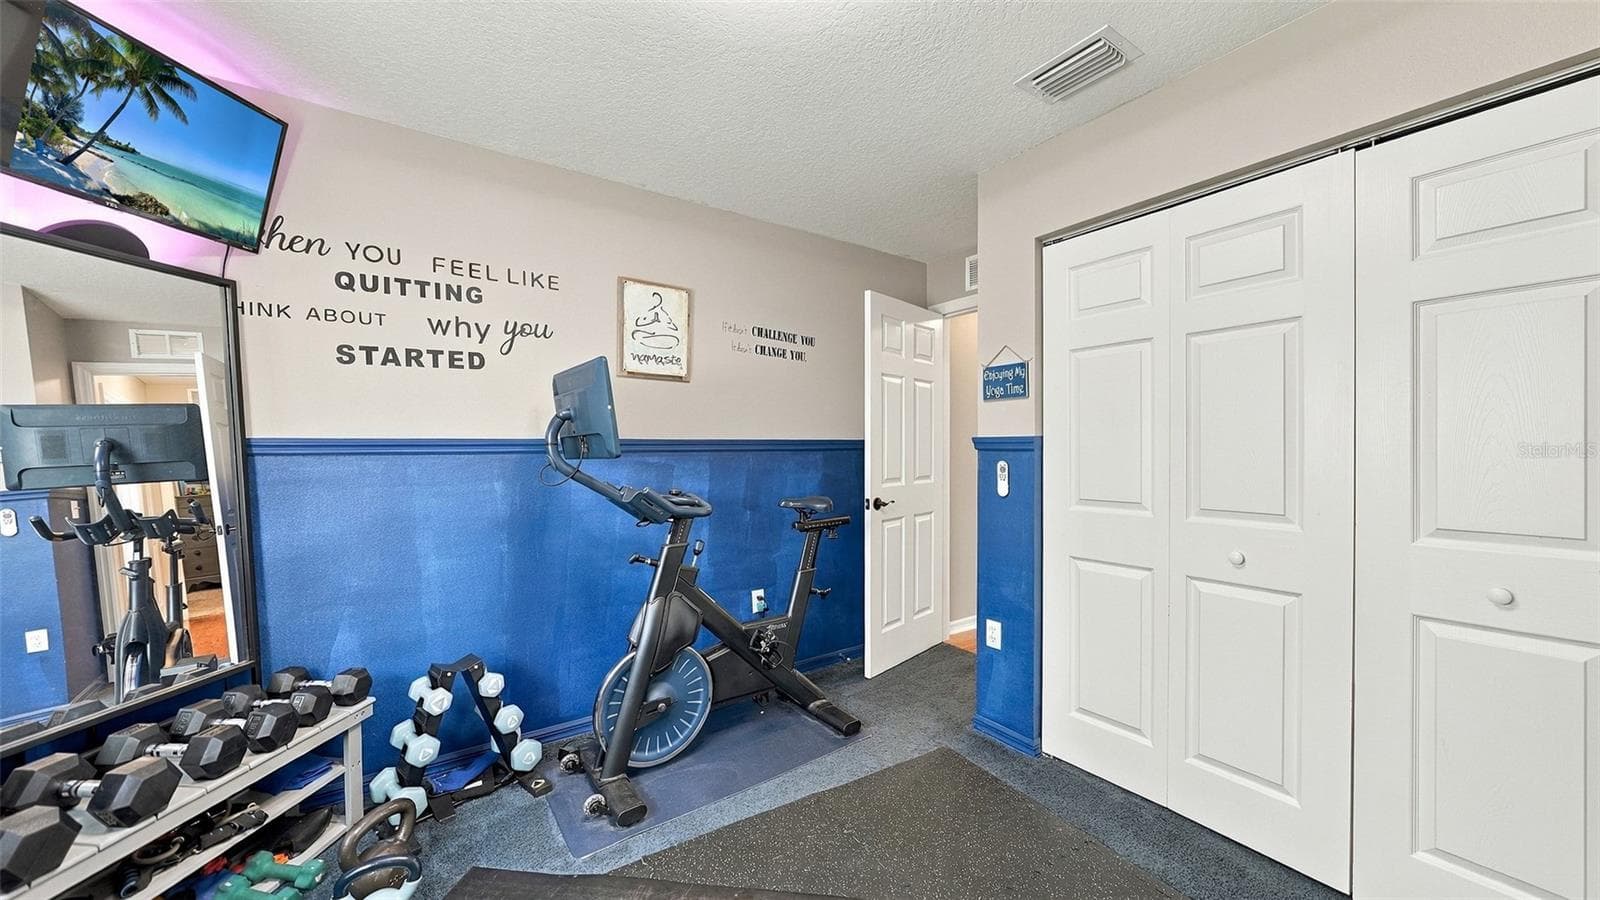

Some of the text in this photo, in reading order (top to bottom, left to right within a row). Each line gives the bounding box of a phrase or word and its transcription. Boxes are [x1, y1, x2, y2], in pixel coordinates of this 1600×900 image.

[260, 215, 560, 291] hen YOU FEEL LIKE
[334, 271, 483, 304] QUITTING
[236, 300, 554, 356] HINK ABOUT why you
[751, 325, 798, 344] CHALLENGE
[799, 334, 816, 347] YOU
[336, 344, 486, 370] STARTED
[754, 343, 788, 360] CHANGE
[984, 369, 1013, 381] Enjoying
[985, 382, 1024, 398] Yoga Time
